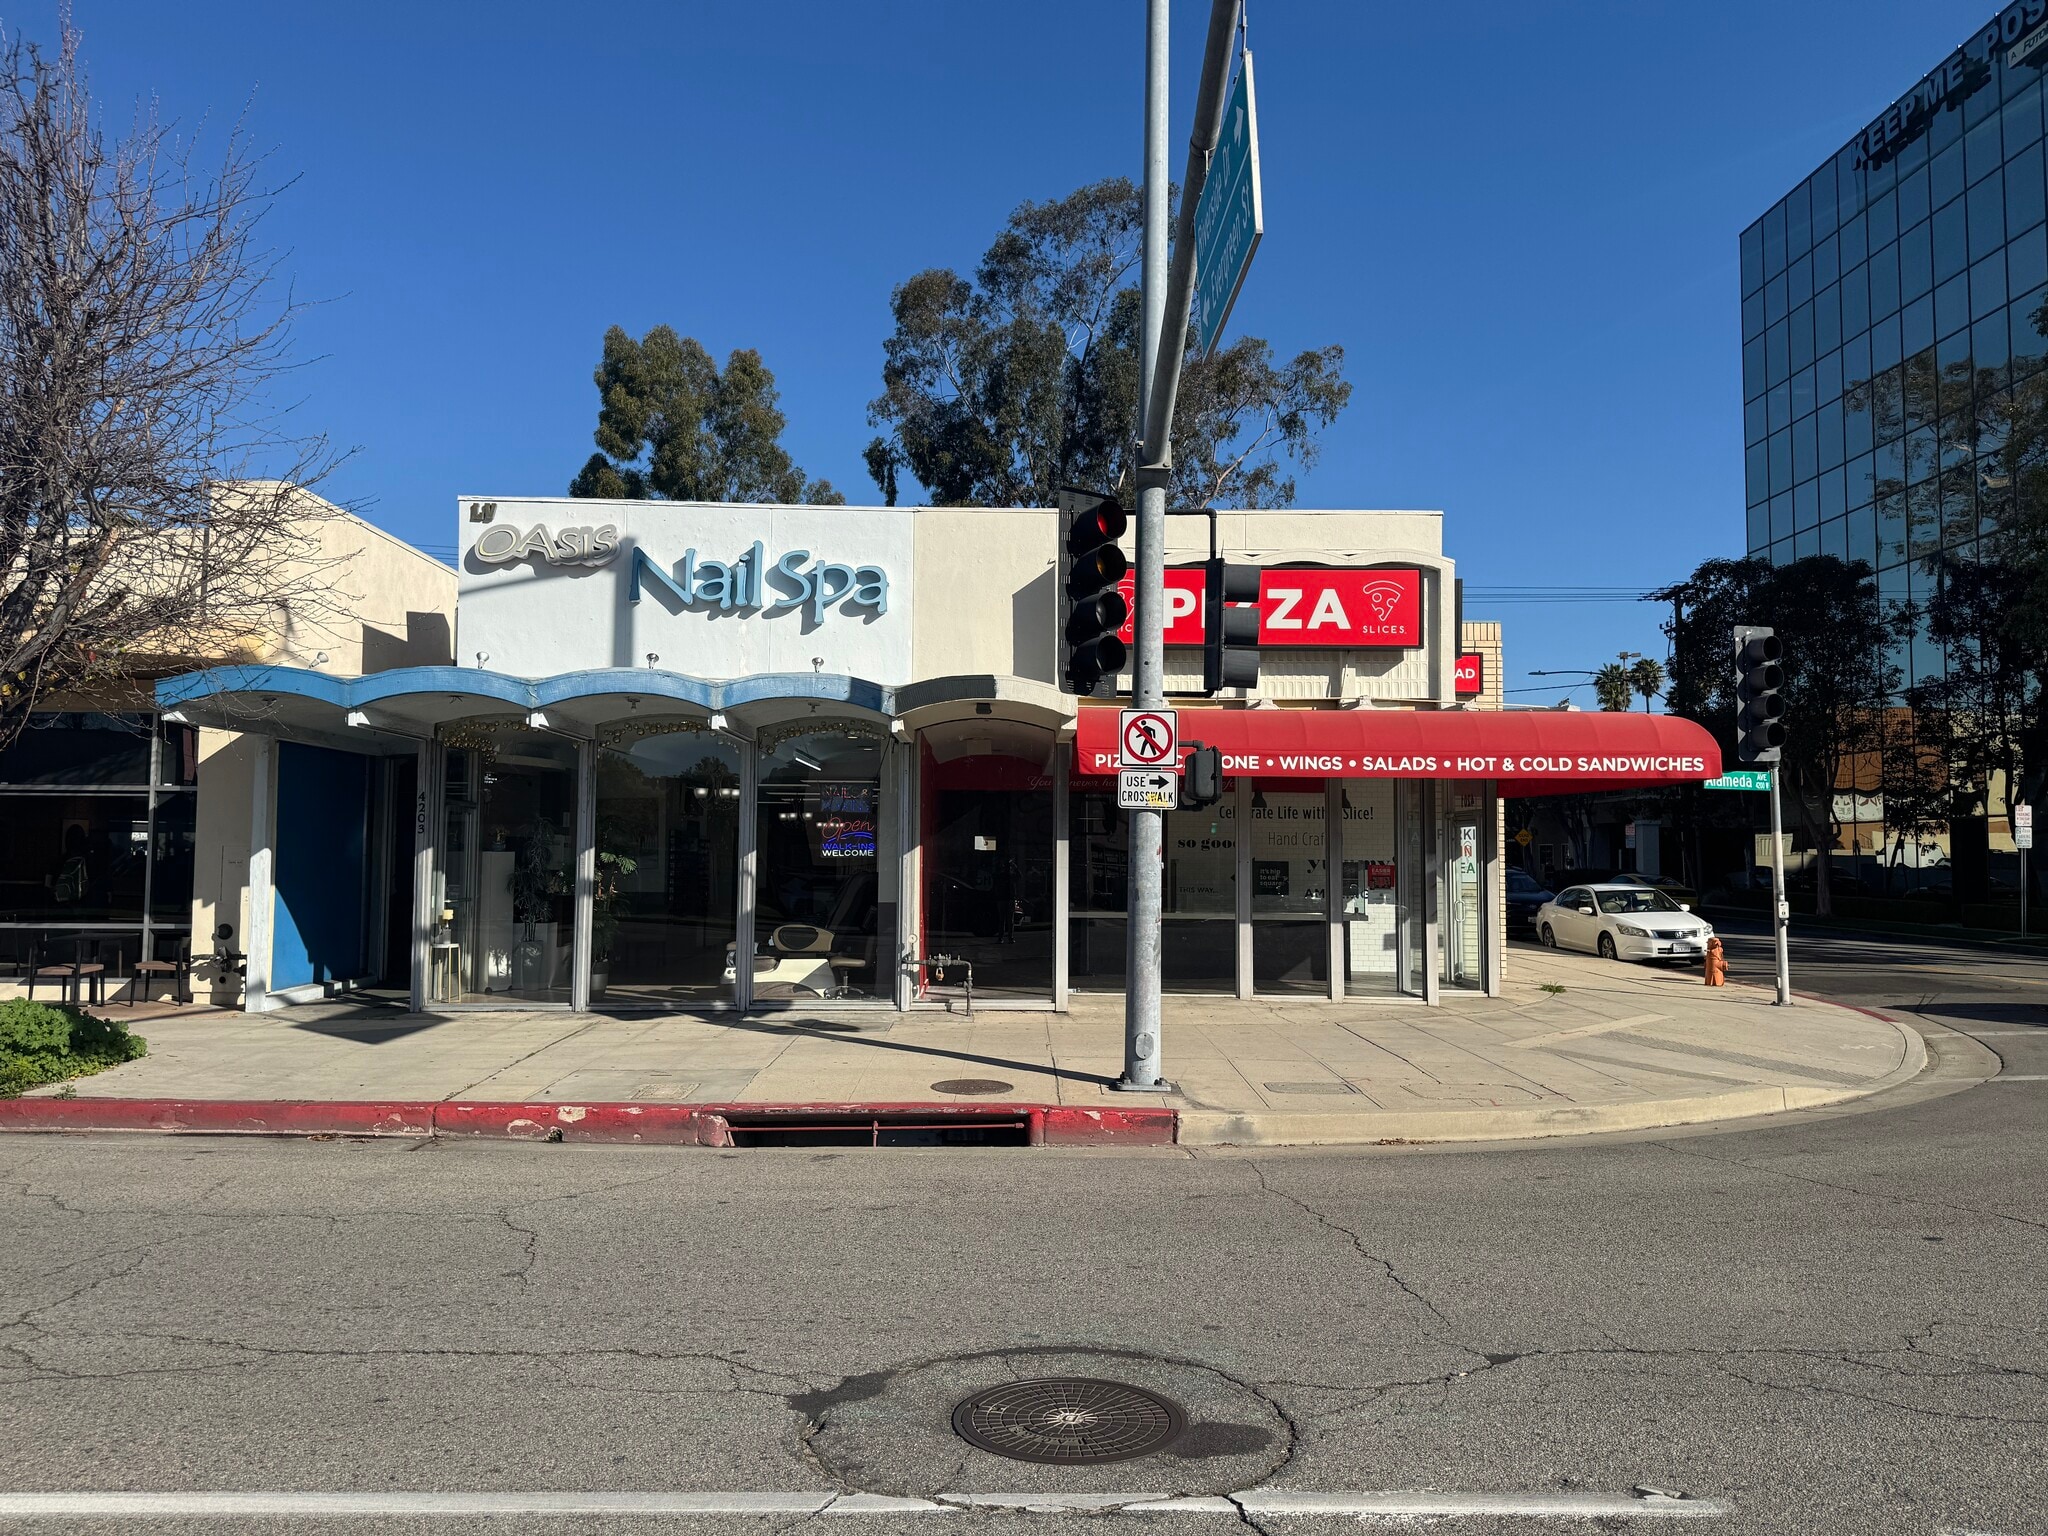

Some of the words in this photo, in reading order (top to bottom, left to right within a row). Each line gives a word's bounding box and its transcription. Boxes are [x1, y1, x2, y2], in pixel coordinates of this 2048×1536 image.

[1851, 98, 1917, 167] KEEP
[1923, 52, 1964, 112] ME
[1198, 170, 1223, 262] Riverside
[1222, 144, 1231, 188] Dr
[1210, 212, 1242, 309] Evergreen
[1241, 180, 1251, 230] St
[628, 540, 764, 610] Nail
[774, 549, 889, 624] Spa
[1163, 588, 1351, 630] PZA
[1362, 625, 1406, 634] SLICES
[1279, 756, 1343, 770] WINGS
[1362, 756, 1437, 771] SALADS
[1457, 757, 1497, 771] HOT
[1502, 757, 1515, 772] &
[1519, 757, 1572, 771] COLD
[1577, 757, 1705, 772] SANDWICHES
[1126, 775, 1147, 788] USE
[1756, 773, 1767, 781] AVE
[1121, 790, 1174, 803] CROSSWALK
[417, 791, 426, 834] 4203
[1219, 806, 1273, 820] Celrate
[1278, 806, 1299, 819] Life
[1343, 806, 1374, 820] Slice!
[822, 817, 875, 840] Open
[1178, 839, 1196, 848] so
[1268, 832, 1298, 846] Hand
